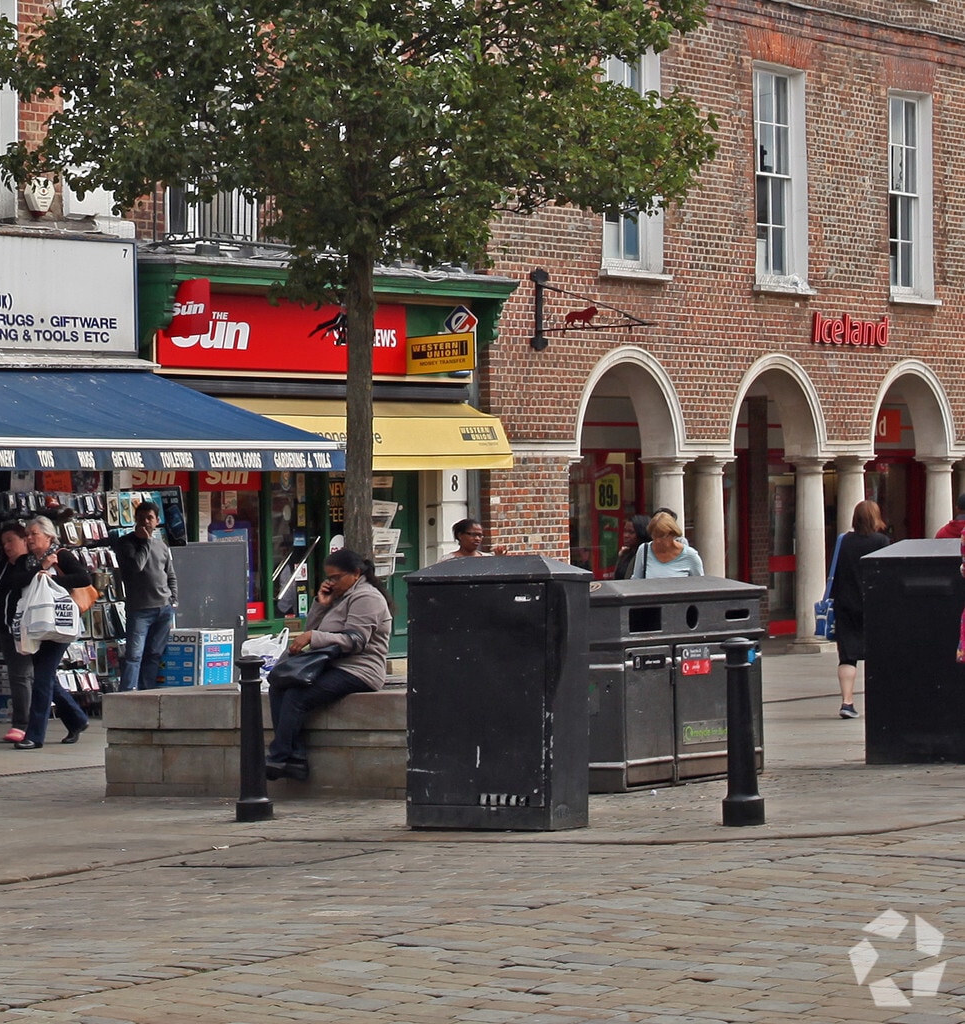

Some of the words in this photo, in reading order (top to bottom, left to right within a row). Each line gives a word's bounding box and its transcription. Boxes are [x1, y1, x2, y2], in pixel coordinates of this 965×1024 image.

[122, 248, 128, 258] 7
[172, 303, 205, 316] Sun
[212, 311, 229, 320] THE
[50, 316, 117, 329] GIFTWARE
[813, 312, 890, 346] Iceland
[22, 330, 32, 342] &
[34, 329, 79, 343] TOOLS
[84, 331, 110, 343] ETC
[412, 342, 459, 353] WESTERN
[426, 349, 459, 359] UNION
[37, 450, 55, 468] TOYS
[273, 452, 306, 468] GARDENING
[132, 471, 176, 485] Sun
[205, 471, 248, 485] Sun
[451, 475, 459, 492] 8
[166, 634, 196, 643] ebara
